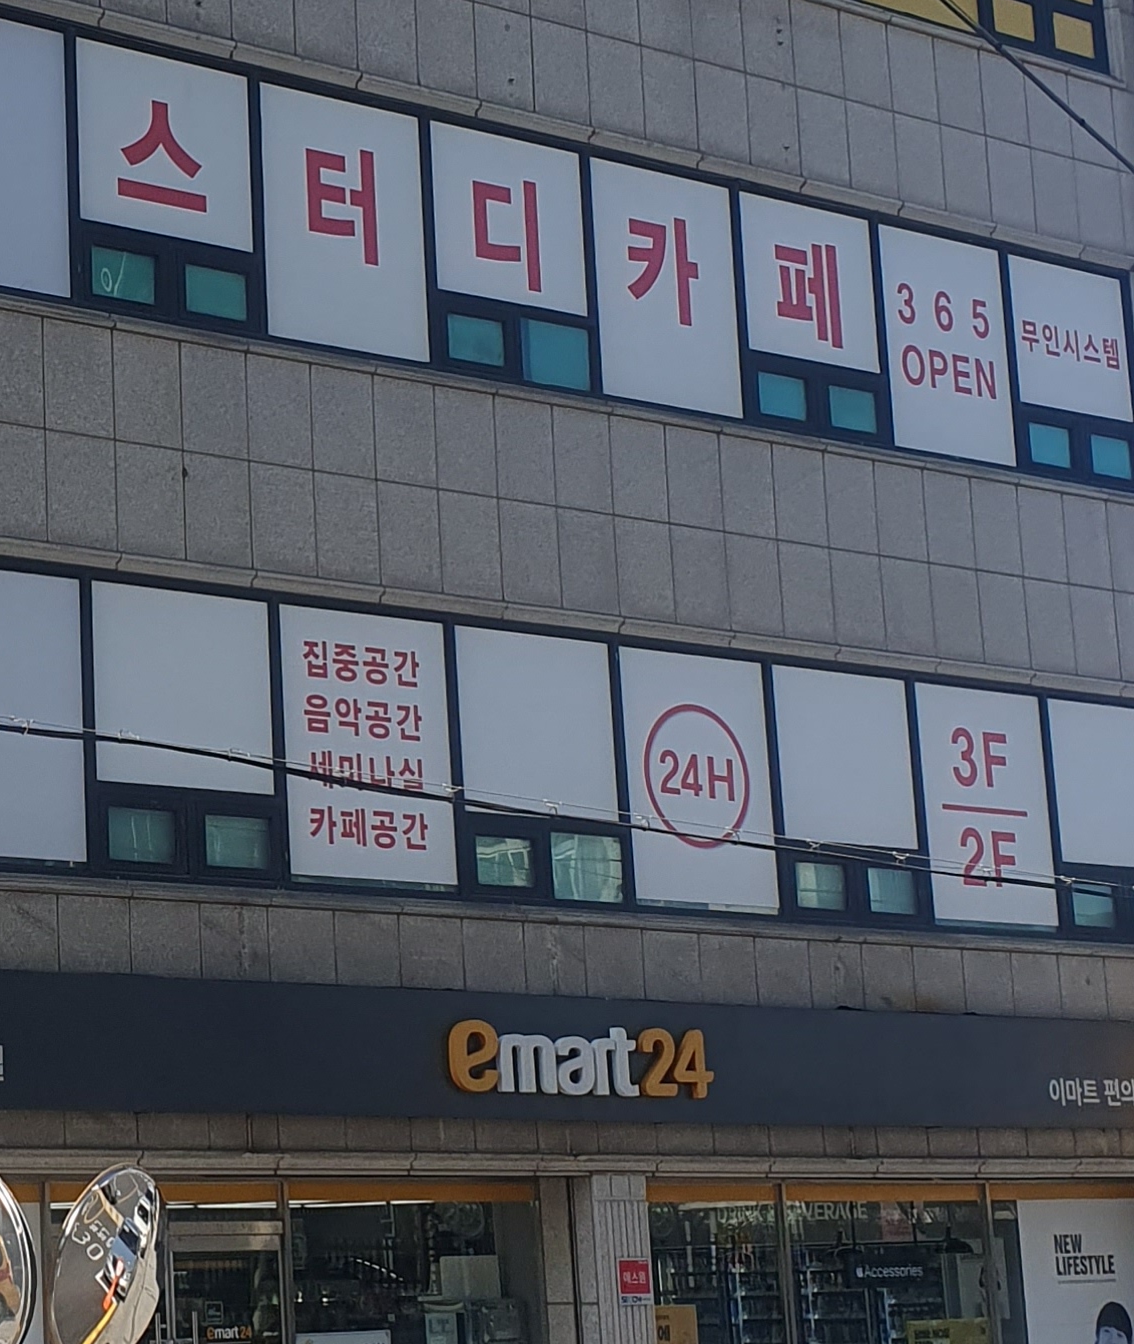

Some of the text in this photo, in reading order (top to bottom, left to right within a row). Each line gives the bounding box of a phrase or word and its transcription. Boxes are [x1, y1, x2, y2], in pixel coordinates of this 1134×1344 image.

[1021, 318, 1121, 371] 무인시스템
[901, 343, 997, 400] OPEN
[302, 639, 420, 689] 집중공간
[302, 693, 423, 743] 음악공간
[308, 749, 425, 793] 세미나실
[659, 748, 735, 803] 24H
[950, 726, 1008, 789] 3F
[308, 805, 429, 852] 카페공간
[959, 826, 1017, 888] 2F
[446, 1018, 715, 1100] emart24
[1048, 1076, 1101, 1107] 이마트
[1052, 1232, 1083, 1255] NEW
[1054, 1254, 1116, 1276] LIFESTYLE
[864, 1263, 924, 1279] Accessories
[206, 1324, 253, 1340] emart24
